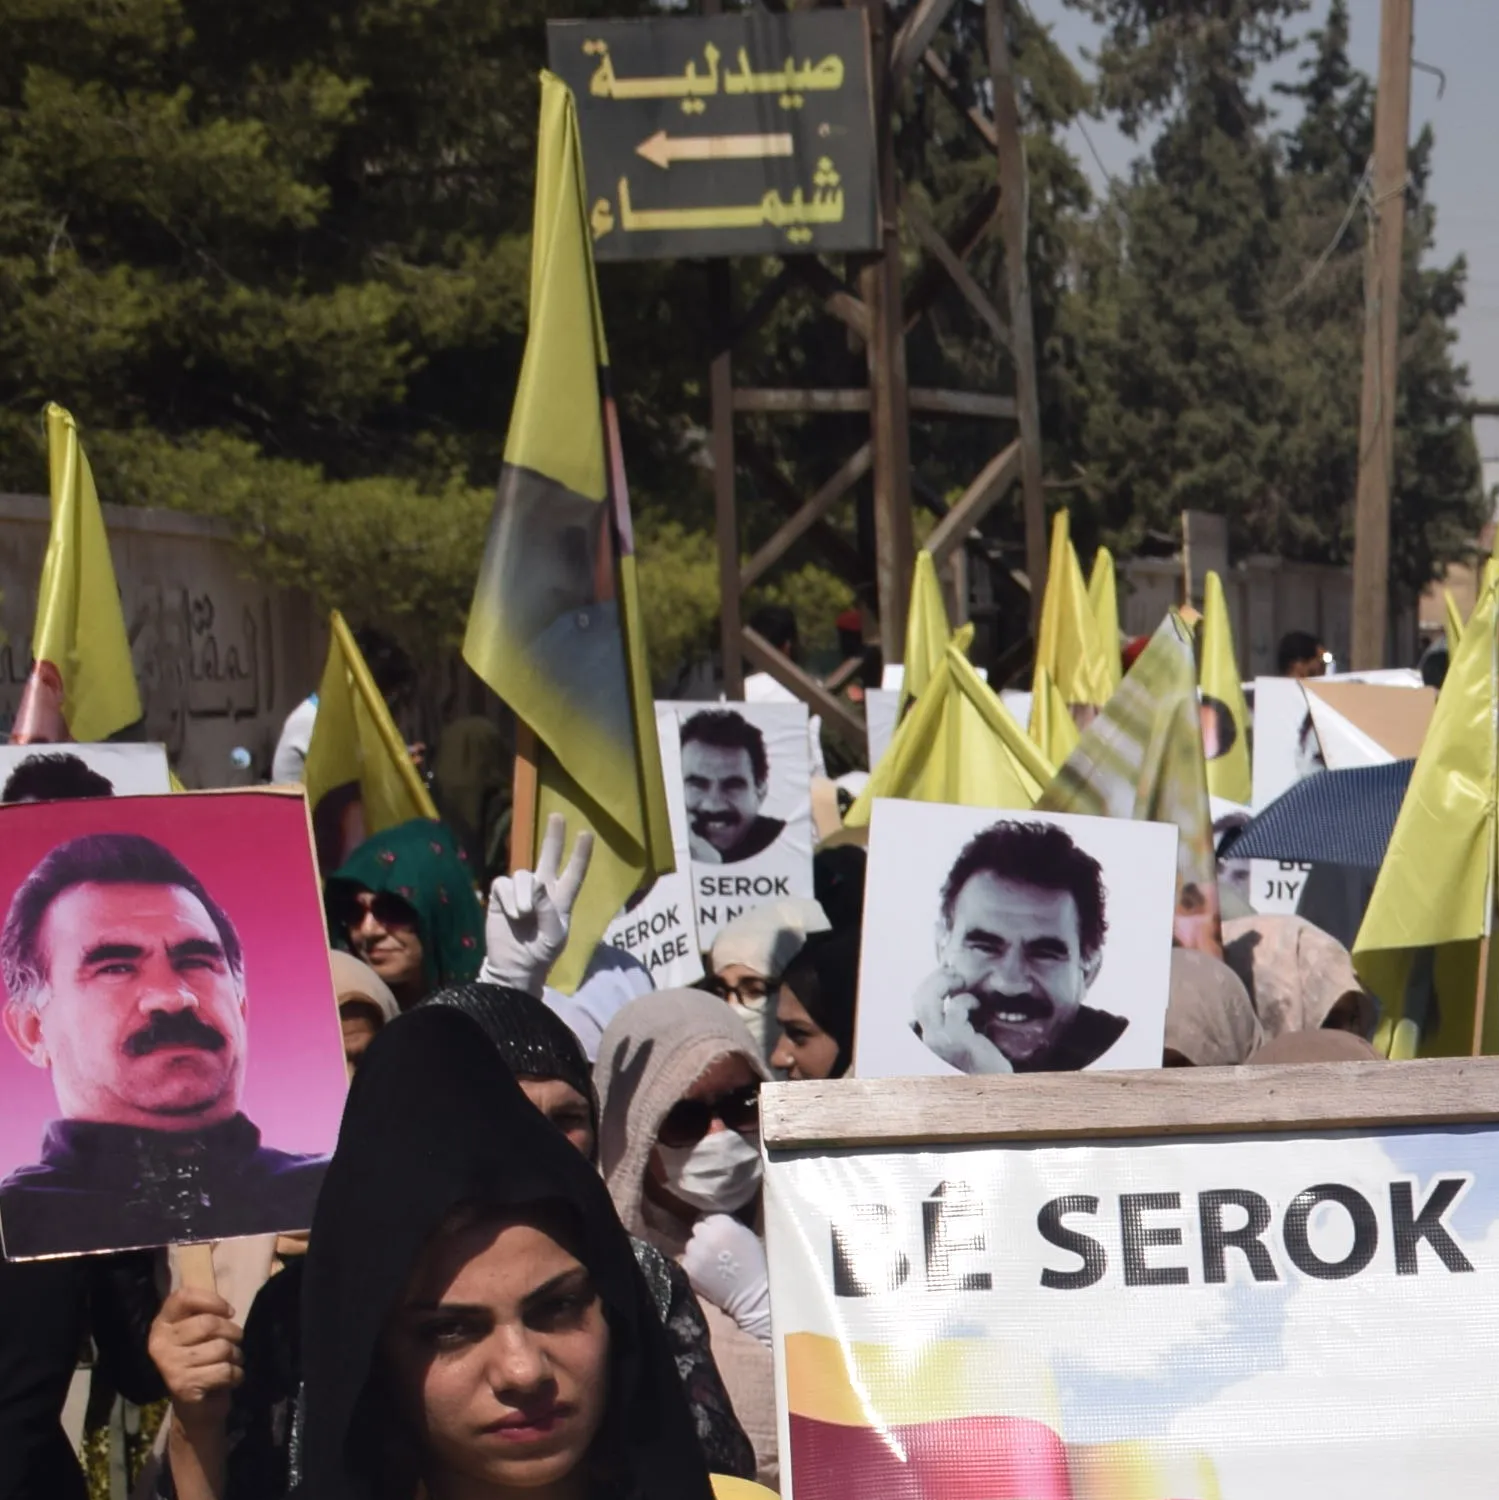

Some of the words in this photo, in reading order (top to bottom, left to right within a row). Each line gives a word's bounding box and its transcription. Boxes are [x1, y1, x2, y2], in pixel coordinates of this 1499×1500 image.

[582, 39, 844, 115] صيدلية
[590, 156, 844, 244] شيماء
[700, 876, 789, 896] SEROK
[1265, 880, 1300, 900] JIY
[612, 904, 681, 951] SEROK
[1037, 1178, 1476, 1290] SEROK
